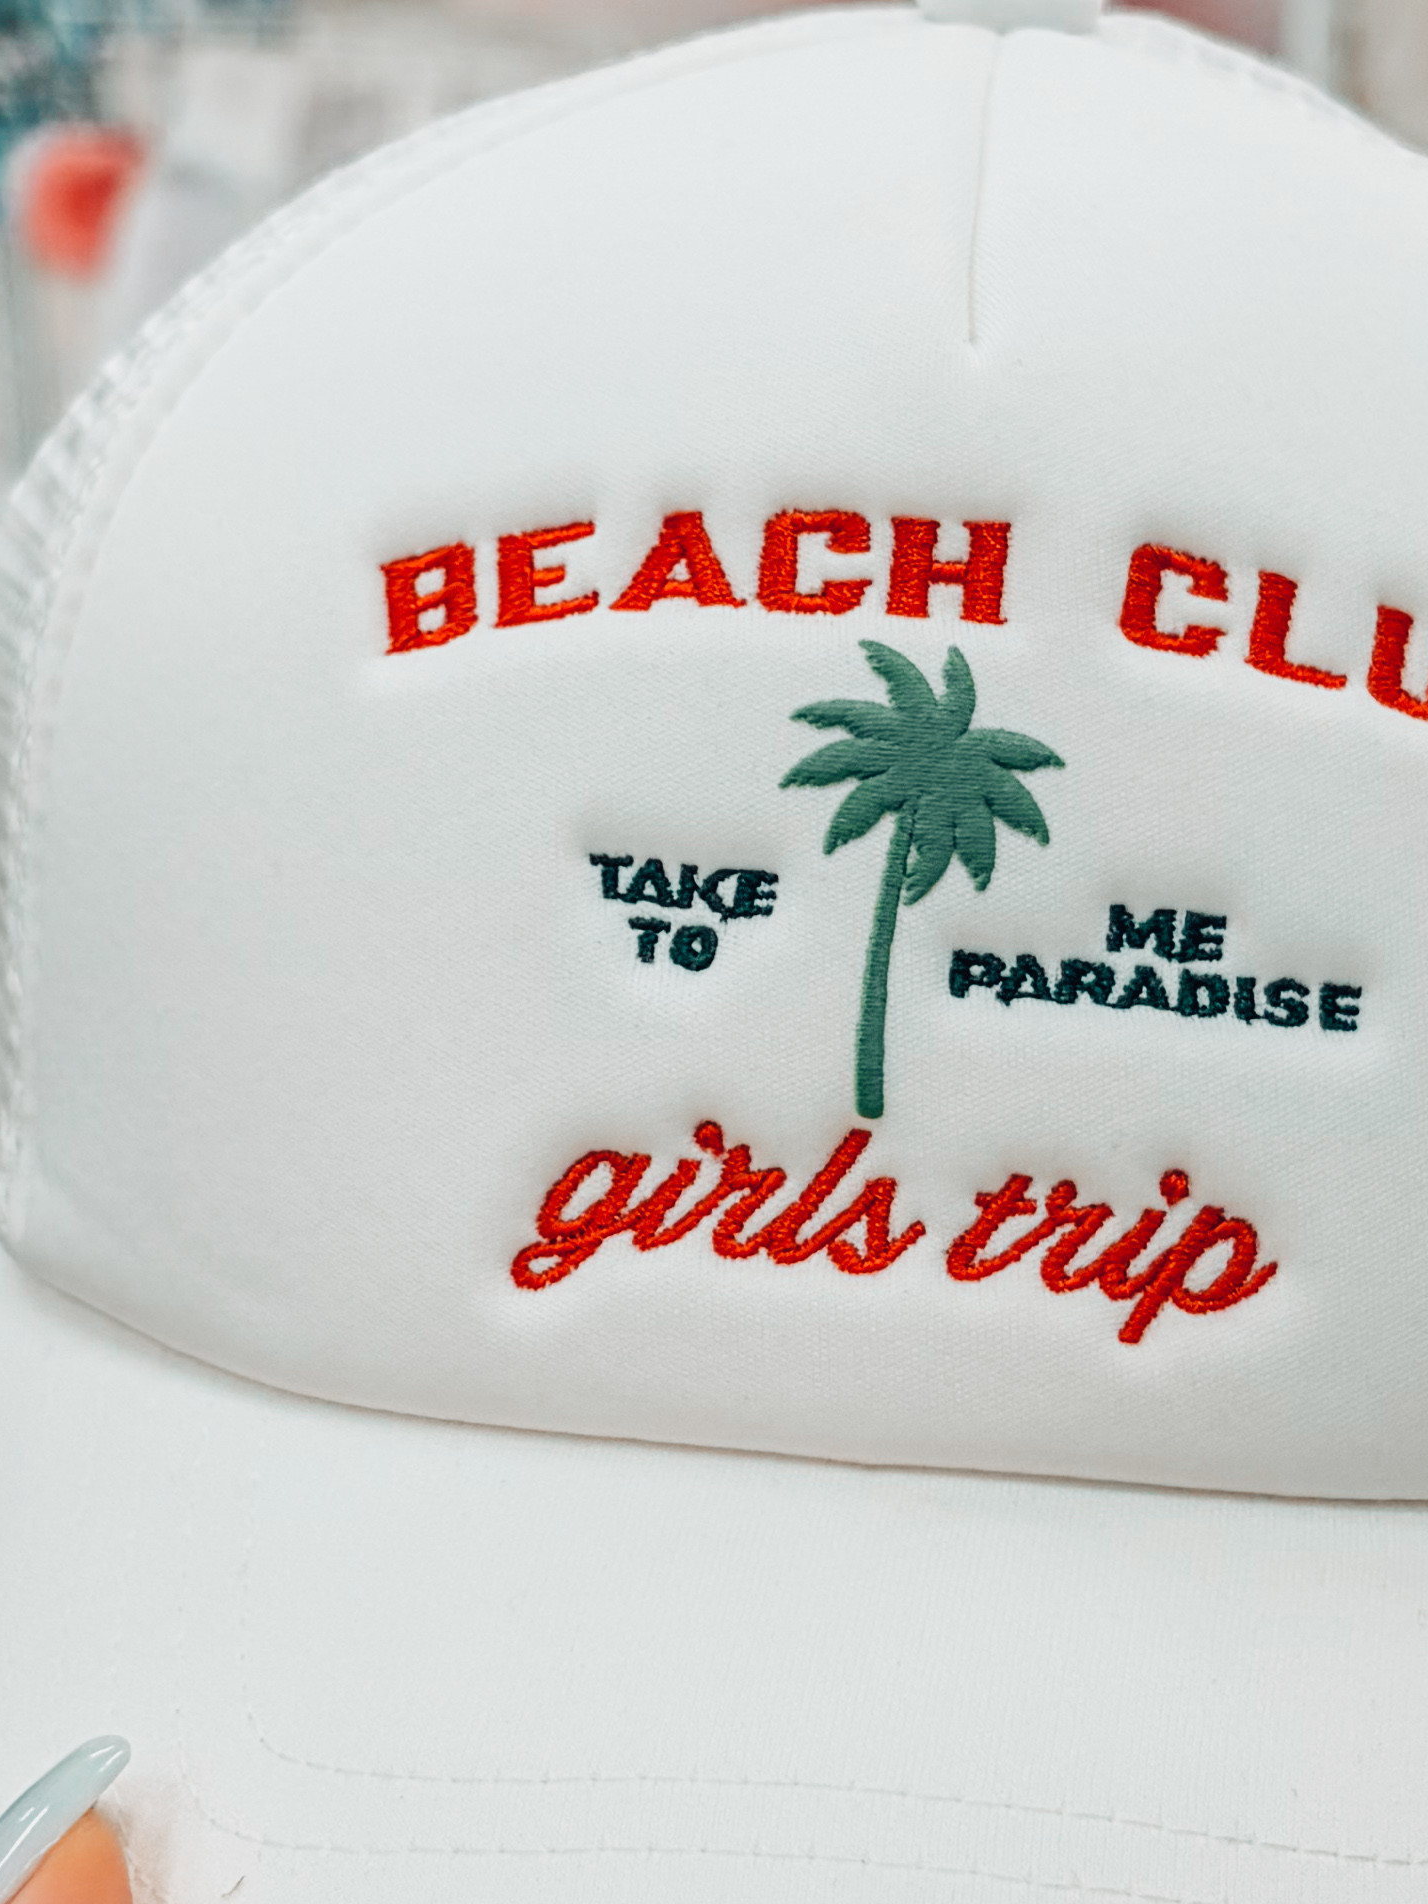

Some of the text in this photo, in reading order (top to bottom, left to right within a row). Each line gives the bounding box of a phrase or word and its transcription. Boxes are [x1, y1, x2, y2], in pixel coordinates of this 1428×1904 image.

[380, 509, 1010, 655] BEACH
[589, 852, 1227, 964] TAKE ME
[628, 916, 1362, 1032] TO PARADISE
[510, 1121, 1276, 1345] girls trip
